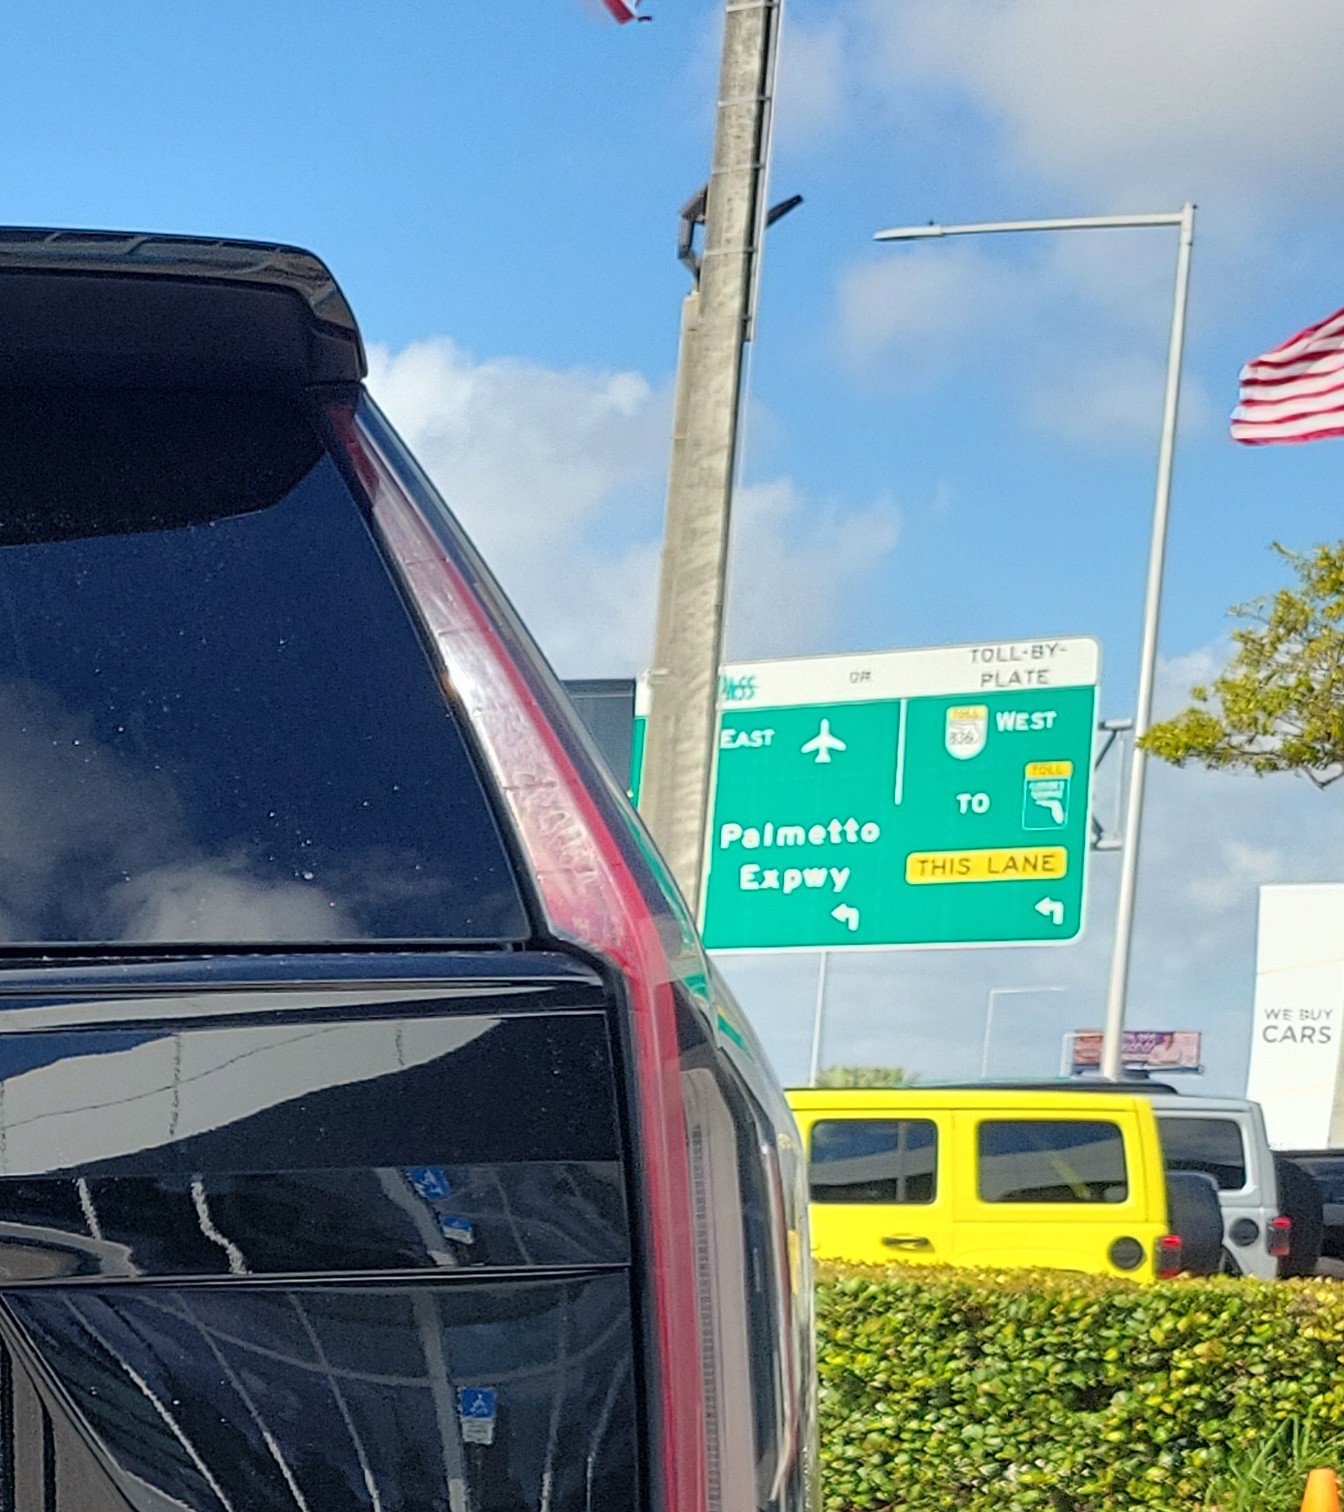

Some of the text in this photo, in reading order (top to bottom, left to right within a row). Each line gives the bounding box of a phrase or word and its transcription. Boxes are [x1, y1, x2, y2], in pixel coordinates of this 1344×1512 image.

[980, 669, 1050, 688] PLATE
[995, 710, 1058, 732] WEST
[719, 728, 776, 749] EAST
[956, 792, 991, 815] TO
[720, 817, 880, 849] Palmetto
[917, 854, 1056, 877] THIS LANE
[739, 863, 851, 894] Expwy
[1264, 1008, 1333, 1020] WE BUY
[1262, 1025, 1331, 1044] CARS
